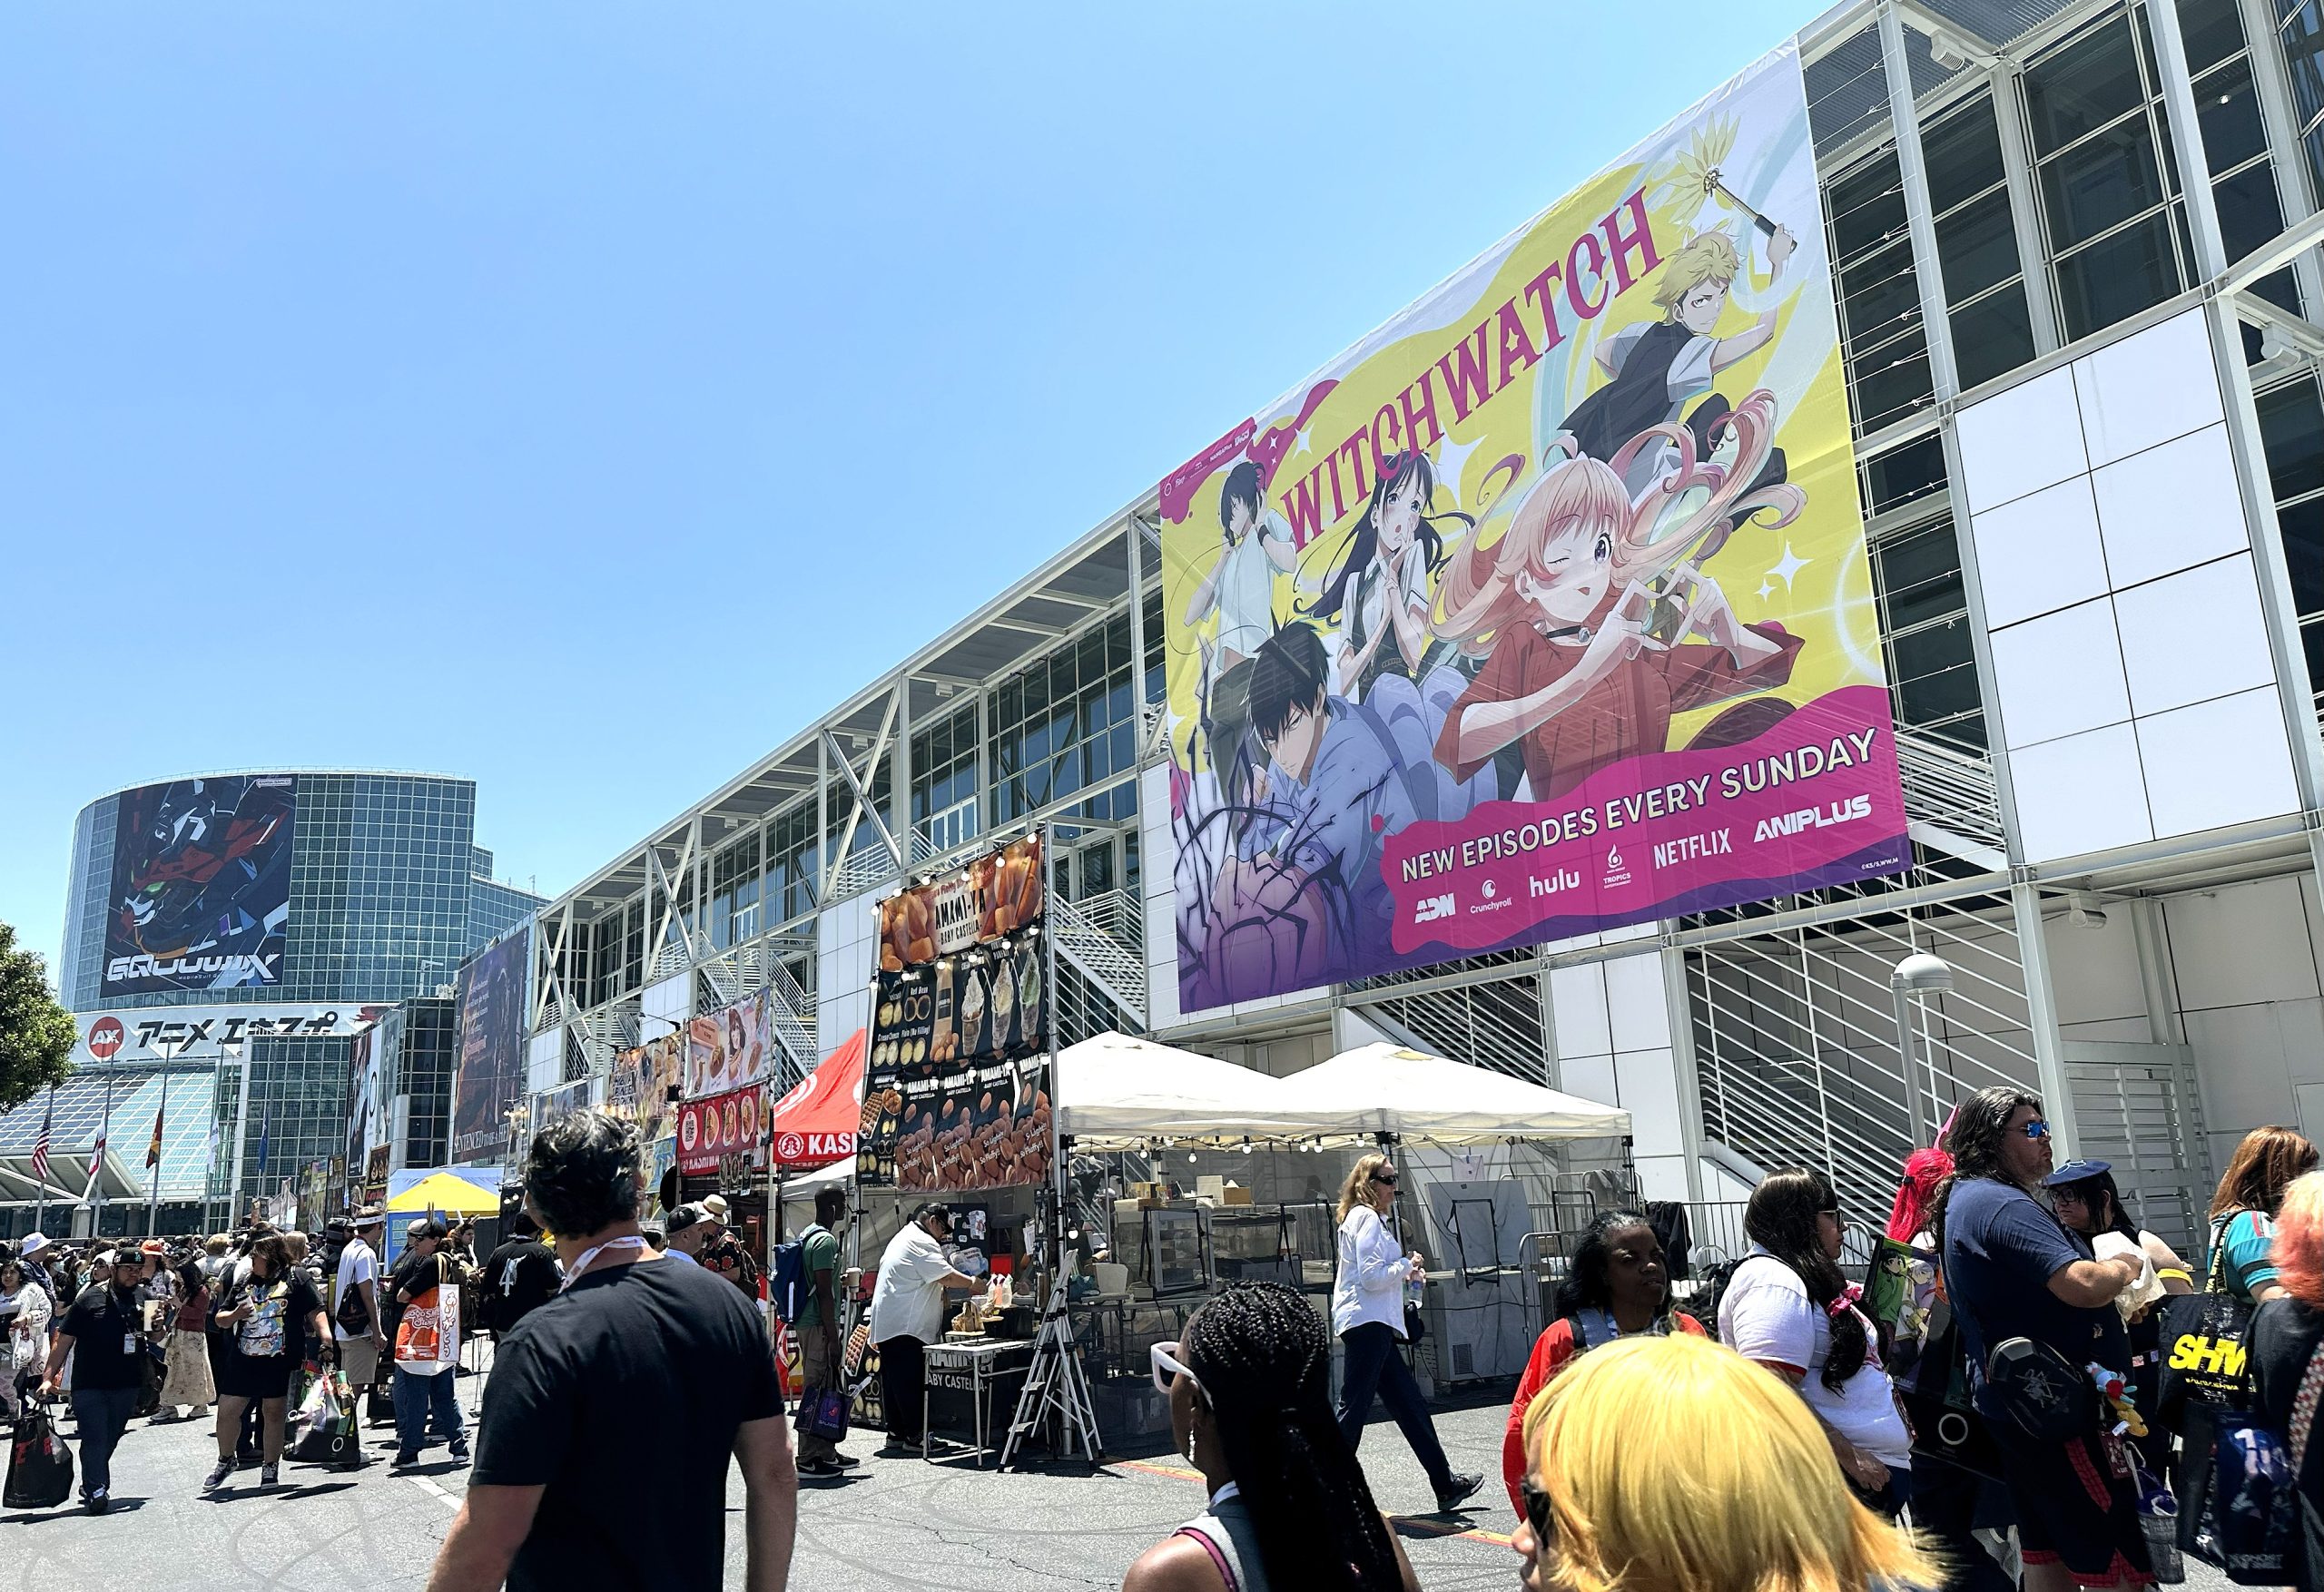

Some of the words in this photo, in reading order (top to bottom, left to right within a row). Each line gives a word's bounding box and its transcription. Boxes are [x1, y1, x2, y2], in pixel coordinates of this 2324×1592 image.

[1280, 367, 1444, 554] WITCH
[1435, 187, 1664, 425] WATCH
[1402, 845, 1455, 883] NEW
[1462, 806, 1599, 867] EPISODES
[1605, 774, 1711, 830] EVERY
[1720, 727, 1877, 799] SUNDAY
[1753, 794, 1873, 842] ANIPLUS
[1653, 827, 1732, 870] NETFLIX
[1529, 869, 1581, 897] hulu
[1603, 872, 1631, 884] TROPICS
[935, 888, 987, 930] AMAMI-YA
[1414, 892, 1456, 923] ADN
[1470, 897, 1512, 914] Crunchyroll
[91, 1028, 120, 1046] AX
[136, 1019, 214, 1052] アニメ
[218, 1011, 338, 1045] エキスポ
[1019, 1053, 1041, 1074] AMAMI-
[442, 1292, 458, 1358] ありがとう
[928, 1373, 943, 1387] ABY
[945, 1375, 989, 1392] CASTELA-
